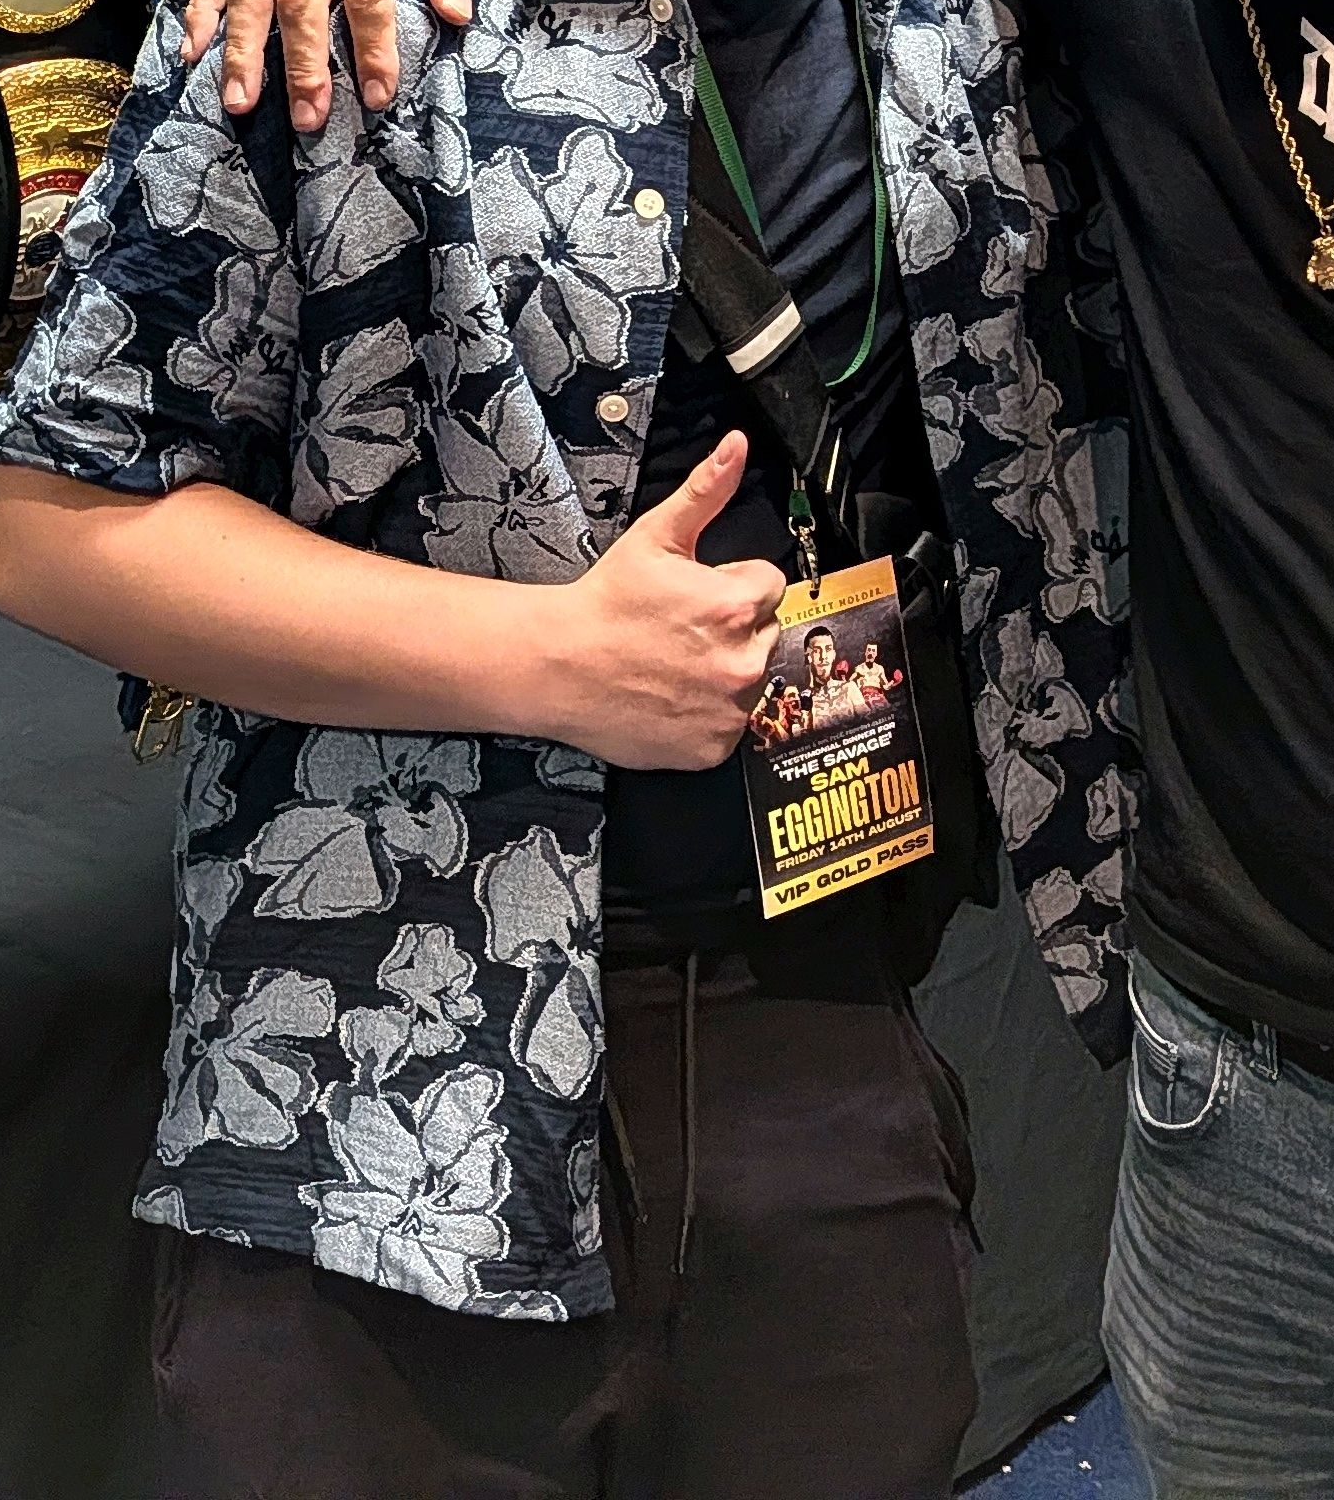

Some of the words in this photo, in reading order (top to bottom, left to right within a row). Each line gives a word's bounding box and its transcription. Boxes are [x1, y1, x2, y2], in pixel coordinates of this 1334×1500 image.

[773, 763, 781, 772] A
[782, 742, 842, 768] TESTIMONIAL
[810, 756, 869, 792] SAM
[767, 759, 920, 859] EGGINGTON
[775, 845, 826, 873] FRIDAY
[829, 829, 865, 852] 14TH
[868, 807, 923, 837] AUGUST
[774, 881, 810, 905] VIP
[816, 857, 872, 889] GOLD
[876, 833, 929, 865] PASS
